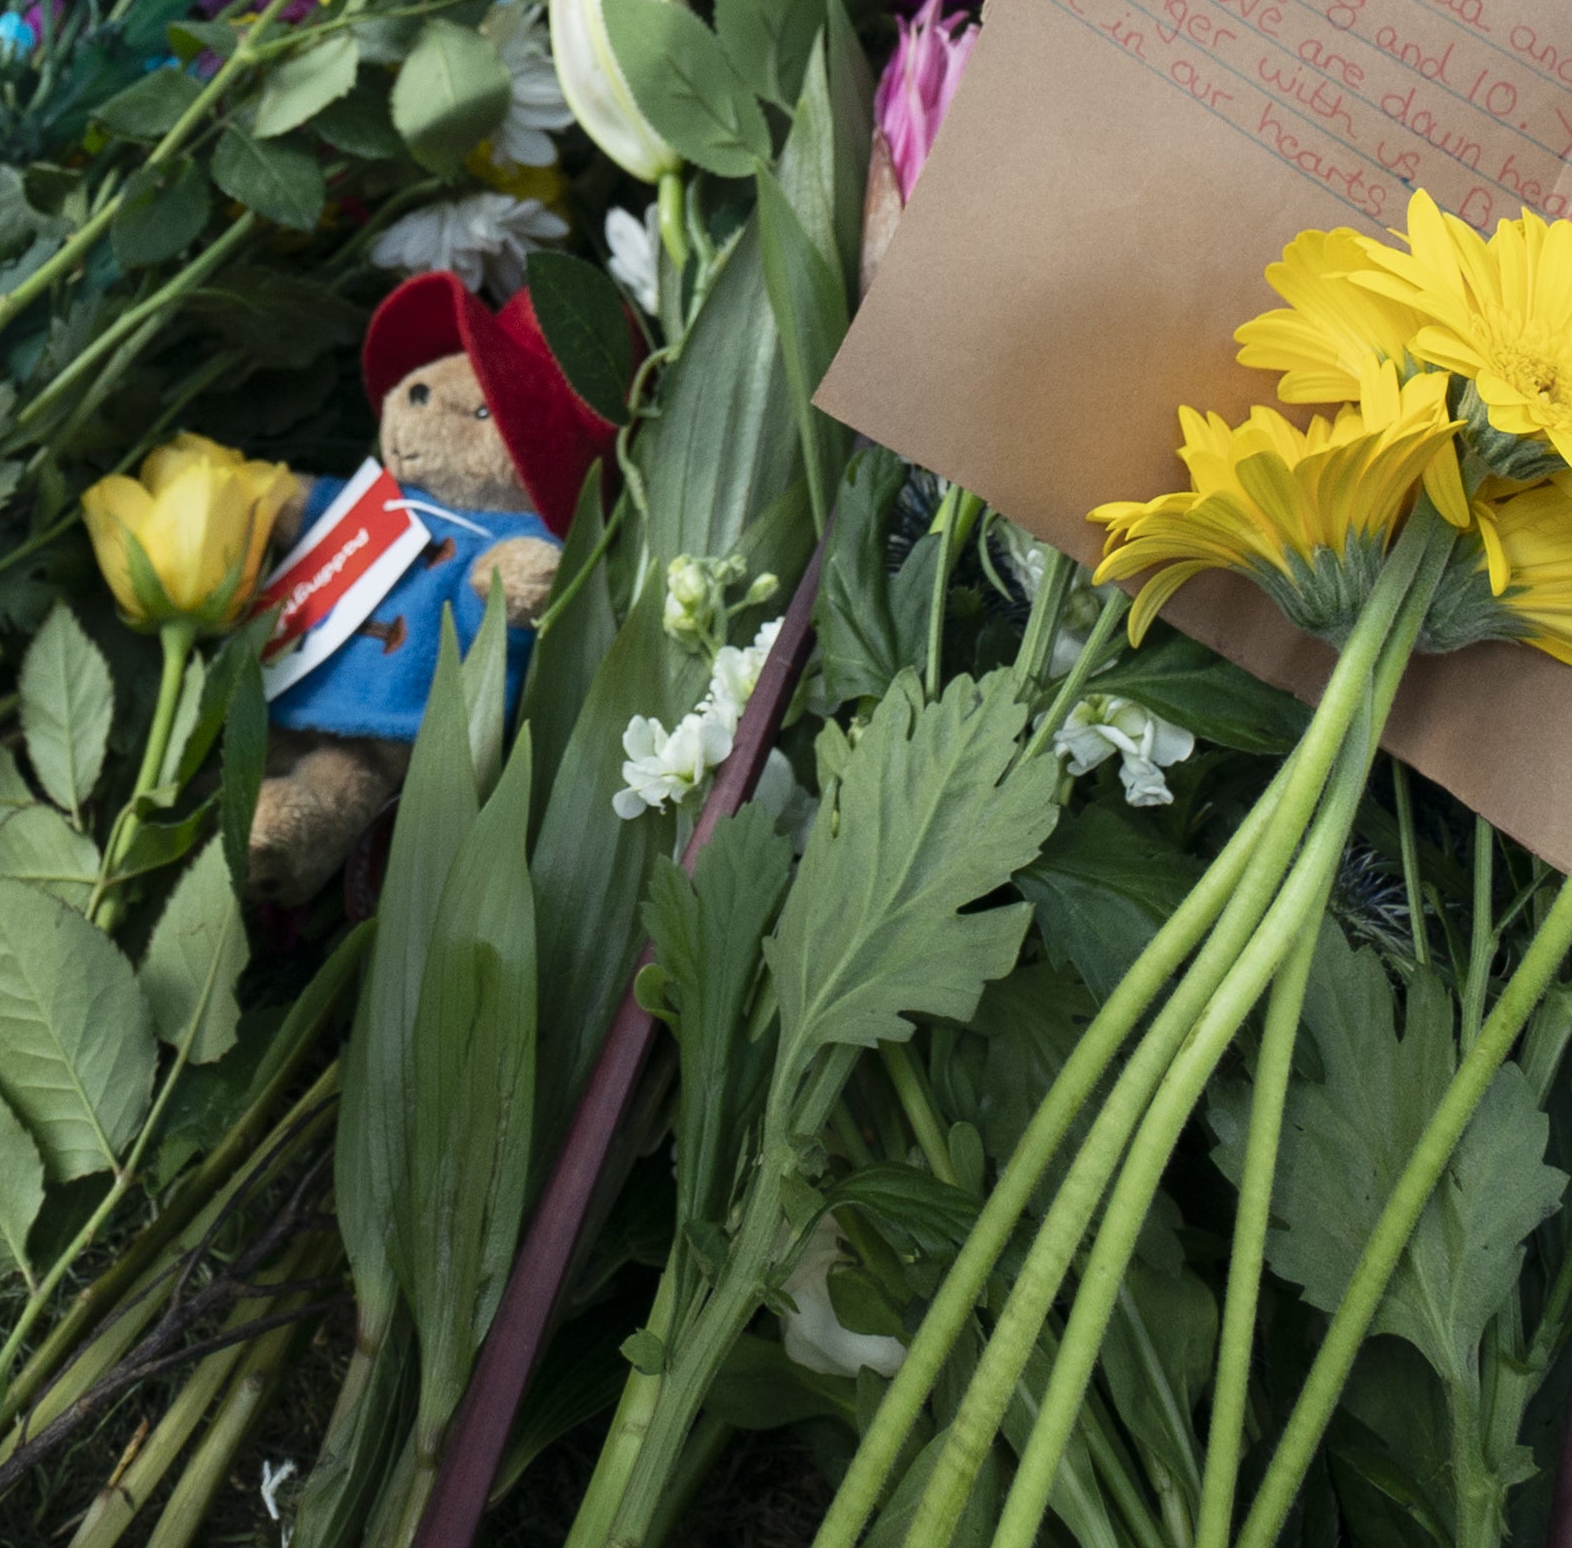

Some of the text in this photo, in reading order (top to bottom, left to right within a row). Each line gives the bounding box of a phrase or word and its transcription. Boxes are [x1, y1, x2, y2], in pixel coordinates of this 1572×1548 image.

[1100, 11, 1147, 60] in
[1170, 59, 1234, 108] our
[1257, 102, 1387, 218] hearts
[1257, 56, 1358, 139] with
[1376, 141, 1421, 182] us
[1297, 38, 1365, 90] are
[1380, 87, 1481, 171] down
[1376, 26, 1456, 86] and
[1468, 68, 1528, 131] 10.
